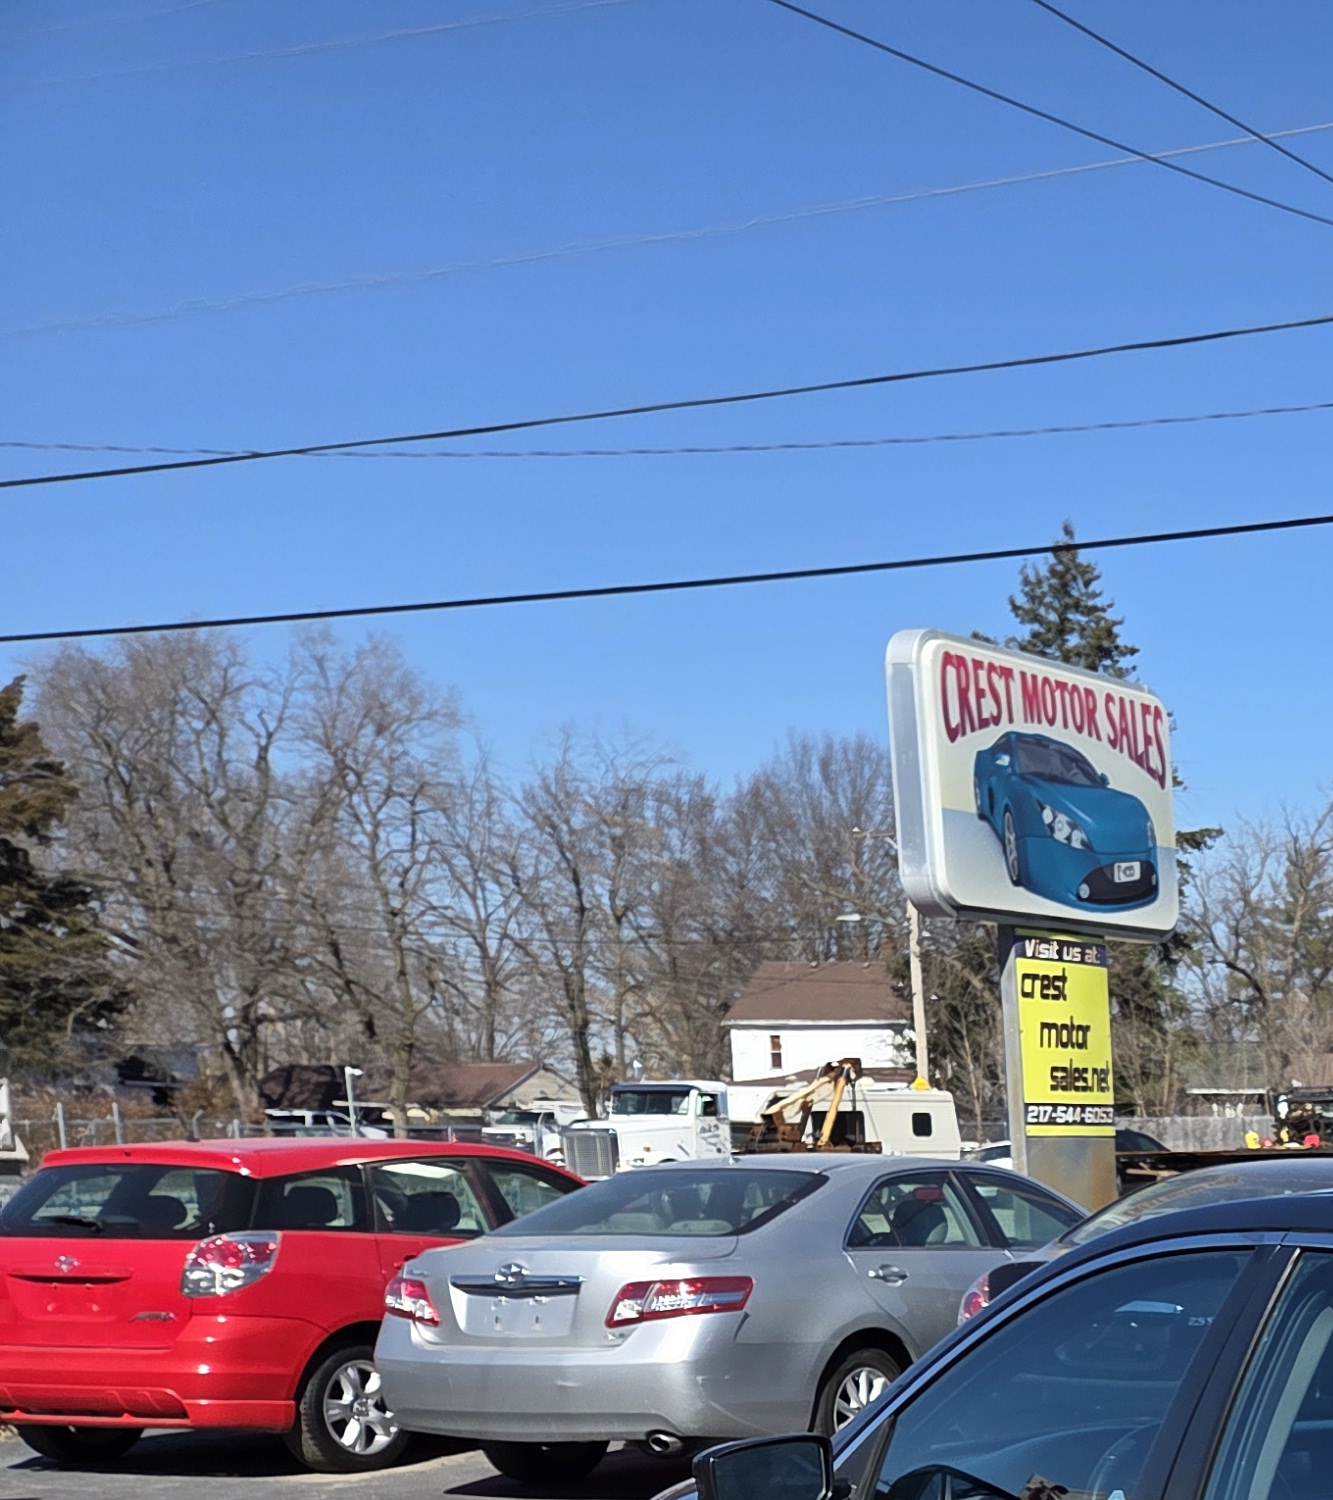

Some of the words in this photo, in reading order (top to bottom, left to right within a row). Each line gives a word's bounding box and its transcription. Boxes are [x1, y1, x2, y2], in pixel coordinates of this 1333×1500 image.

[940, 650, 1015, 744] CREST
[1019, 670, 1103, 742] MOTOR
[1104, 692, 1167, 791] SALES
[1024, 938, 1060, 960] Visit
[1062, 945, 1082, 962] us
[1021, 966, 1068, 1002] crest
[1039, 1015, 1092, 1050] motor
[1049, 1058, 1110, 1093] sales.net
[1026, 1105, 1114, 1124] 217-544-6053
